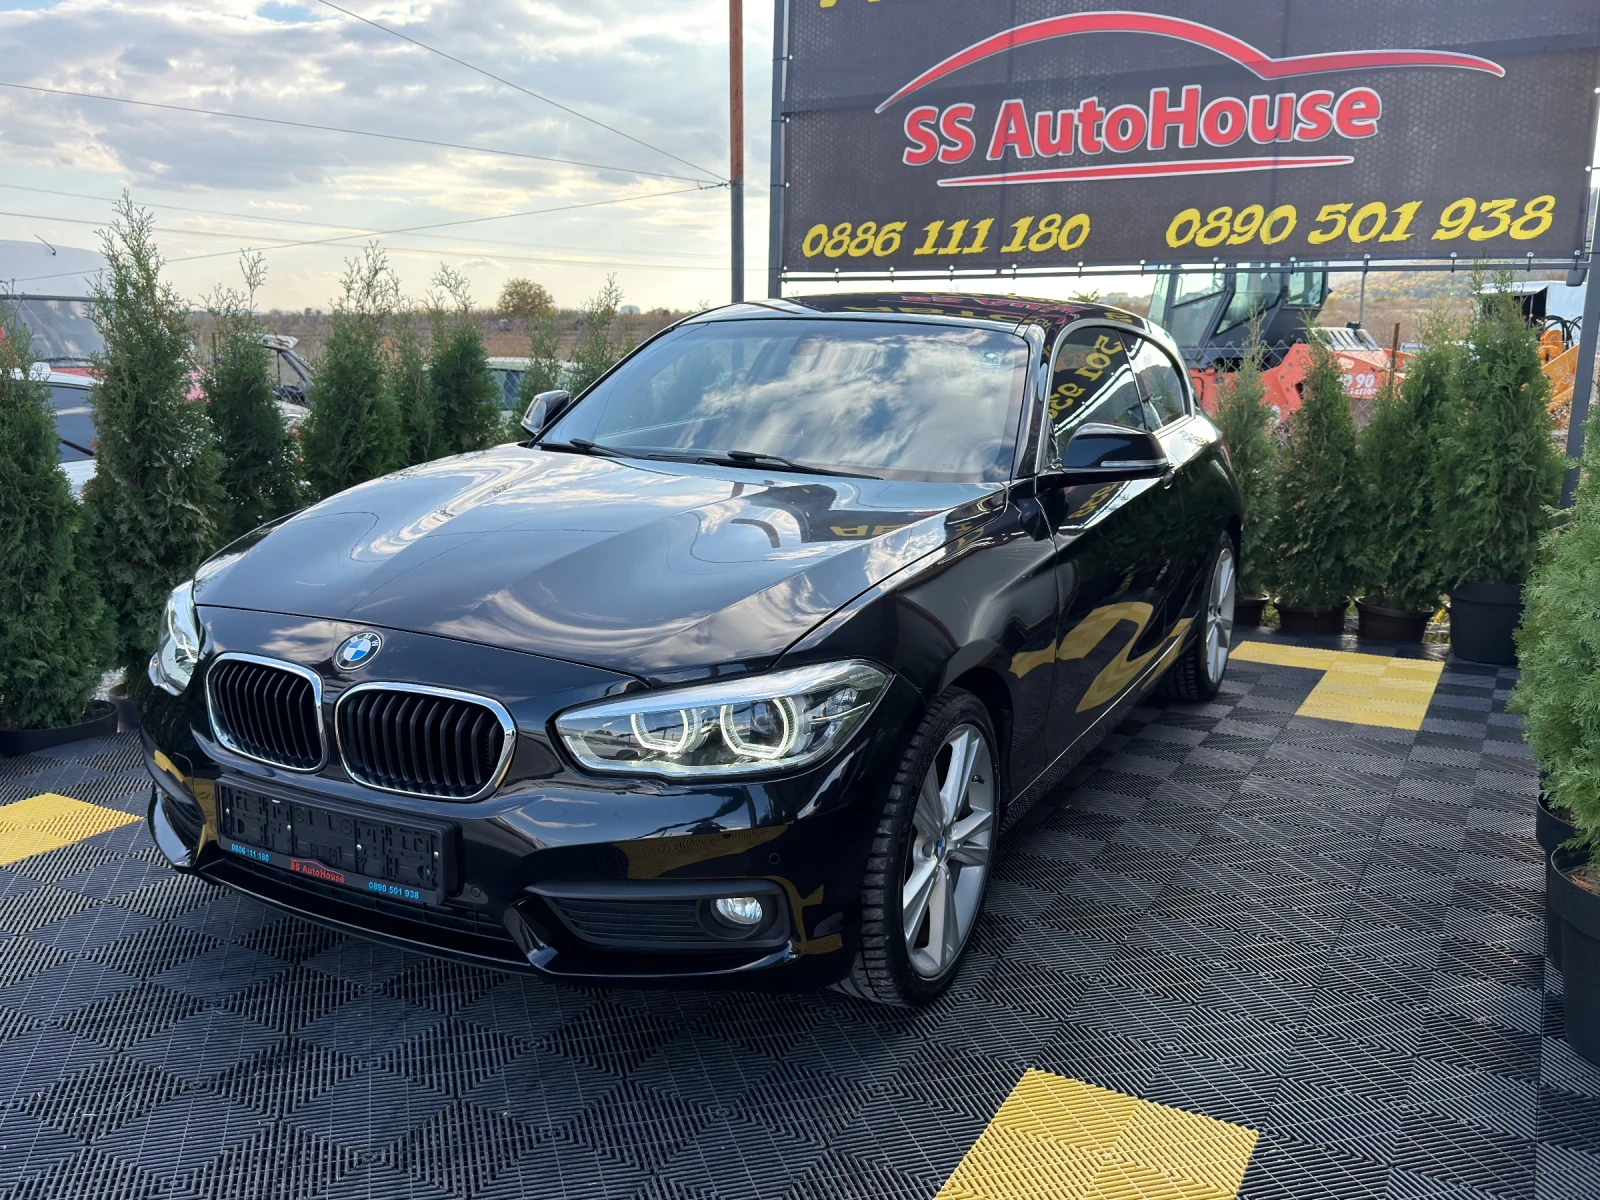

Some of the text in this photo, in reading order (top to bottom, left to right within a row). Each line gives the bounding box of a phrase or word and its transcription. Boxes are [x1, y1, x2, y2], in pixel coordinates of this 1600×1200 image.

[903, 86, 1382, 166] SS AutoHouse
[802, 214, 1091, 258] 0886 111 180
[1166, 195, 1556, 249] 0890 501 938
[231, 844, 270, 862] 0886 111 180
[290, 861, 345, 883] SS AutoHouse
[368, 881, 420, 900] 0890 501 938
